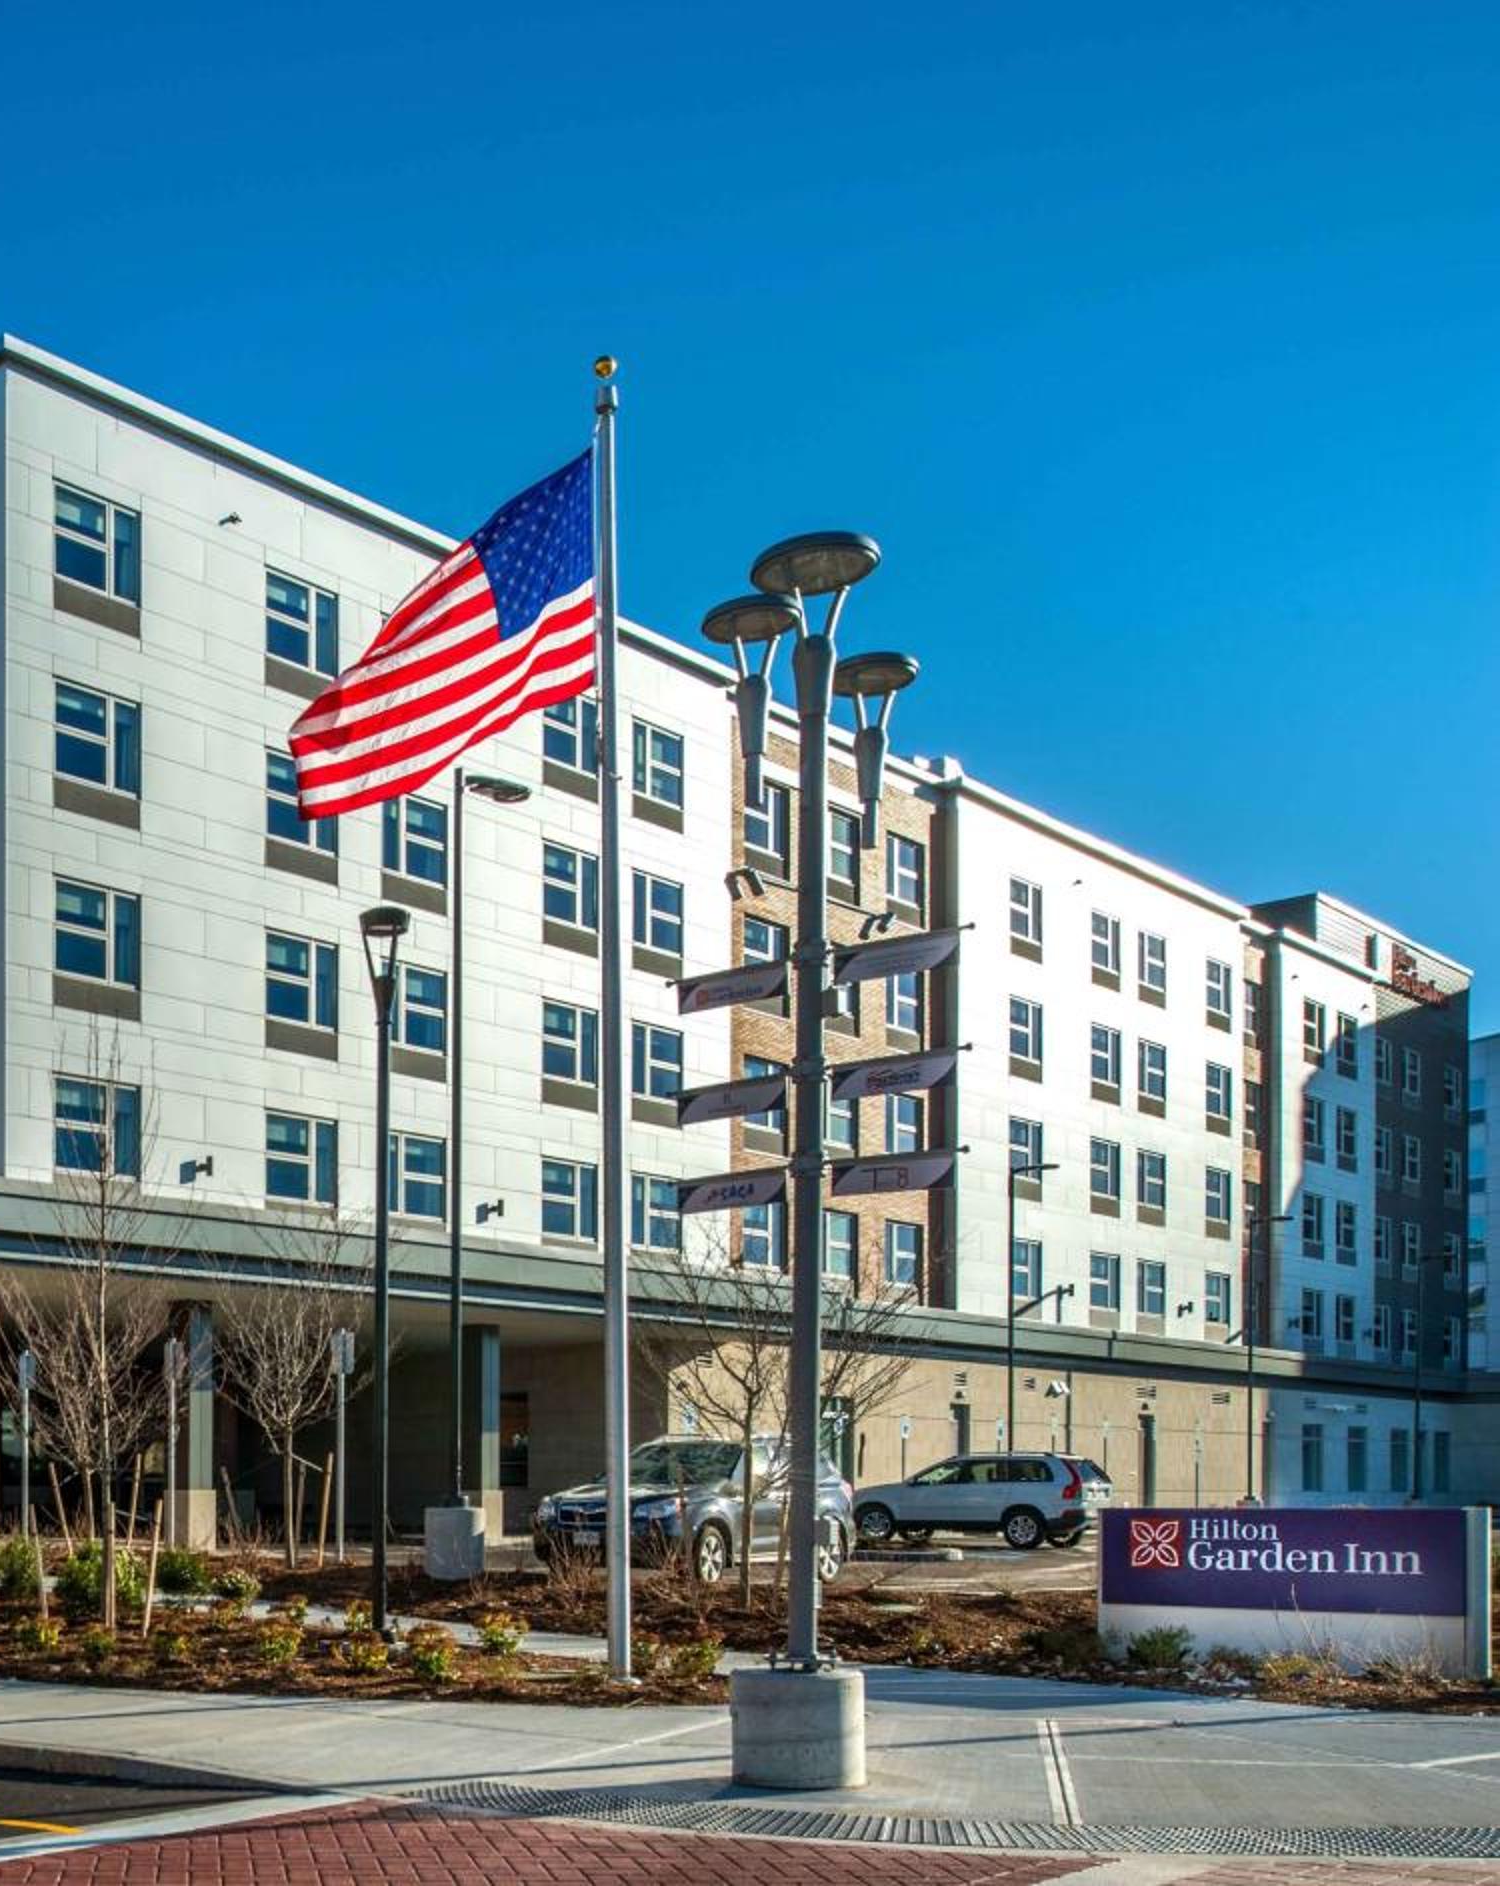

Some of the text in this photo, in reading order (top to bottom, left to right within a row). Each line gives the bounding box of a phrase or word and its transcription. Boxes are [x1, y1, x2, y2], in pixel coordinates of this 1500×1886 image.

[1188, 1517, 1279, 1542] Hilton
[1187, 1541, 1424, 1576] Garden Inn
